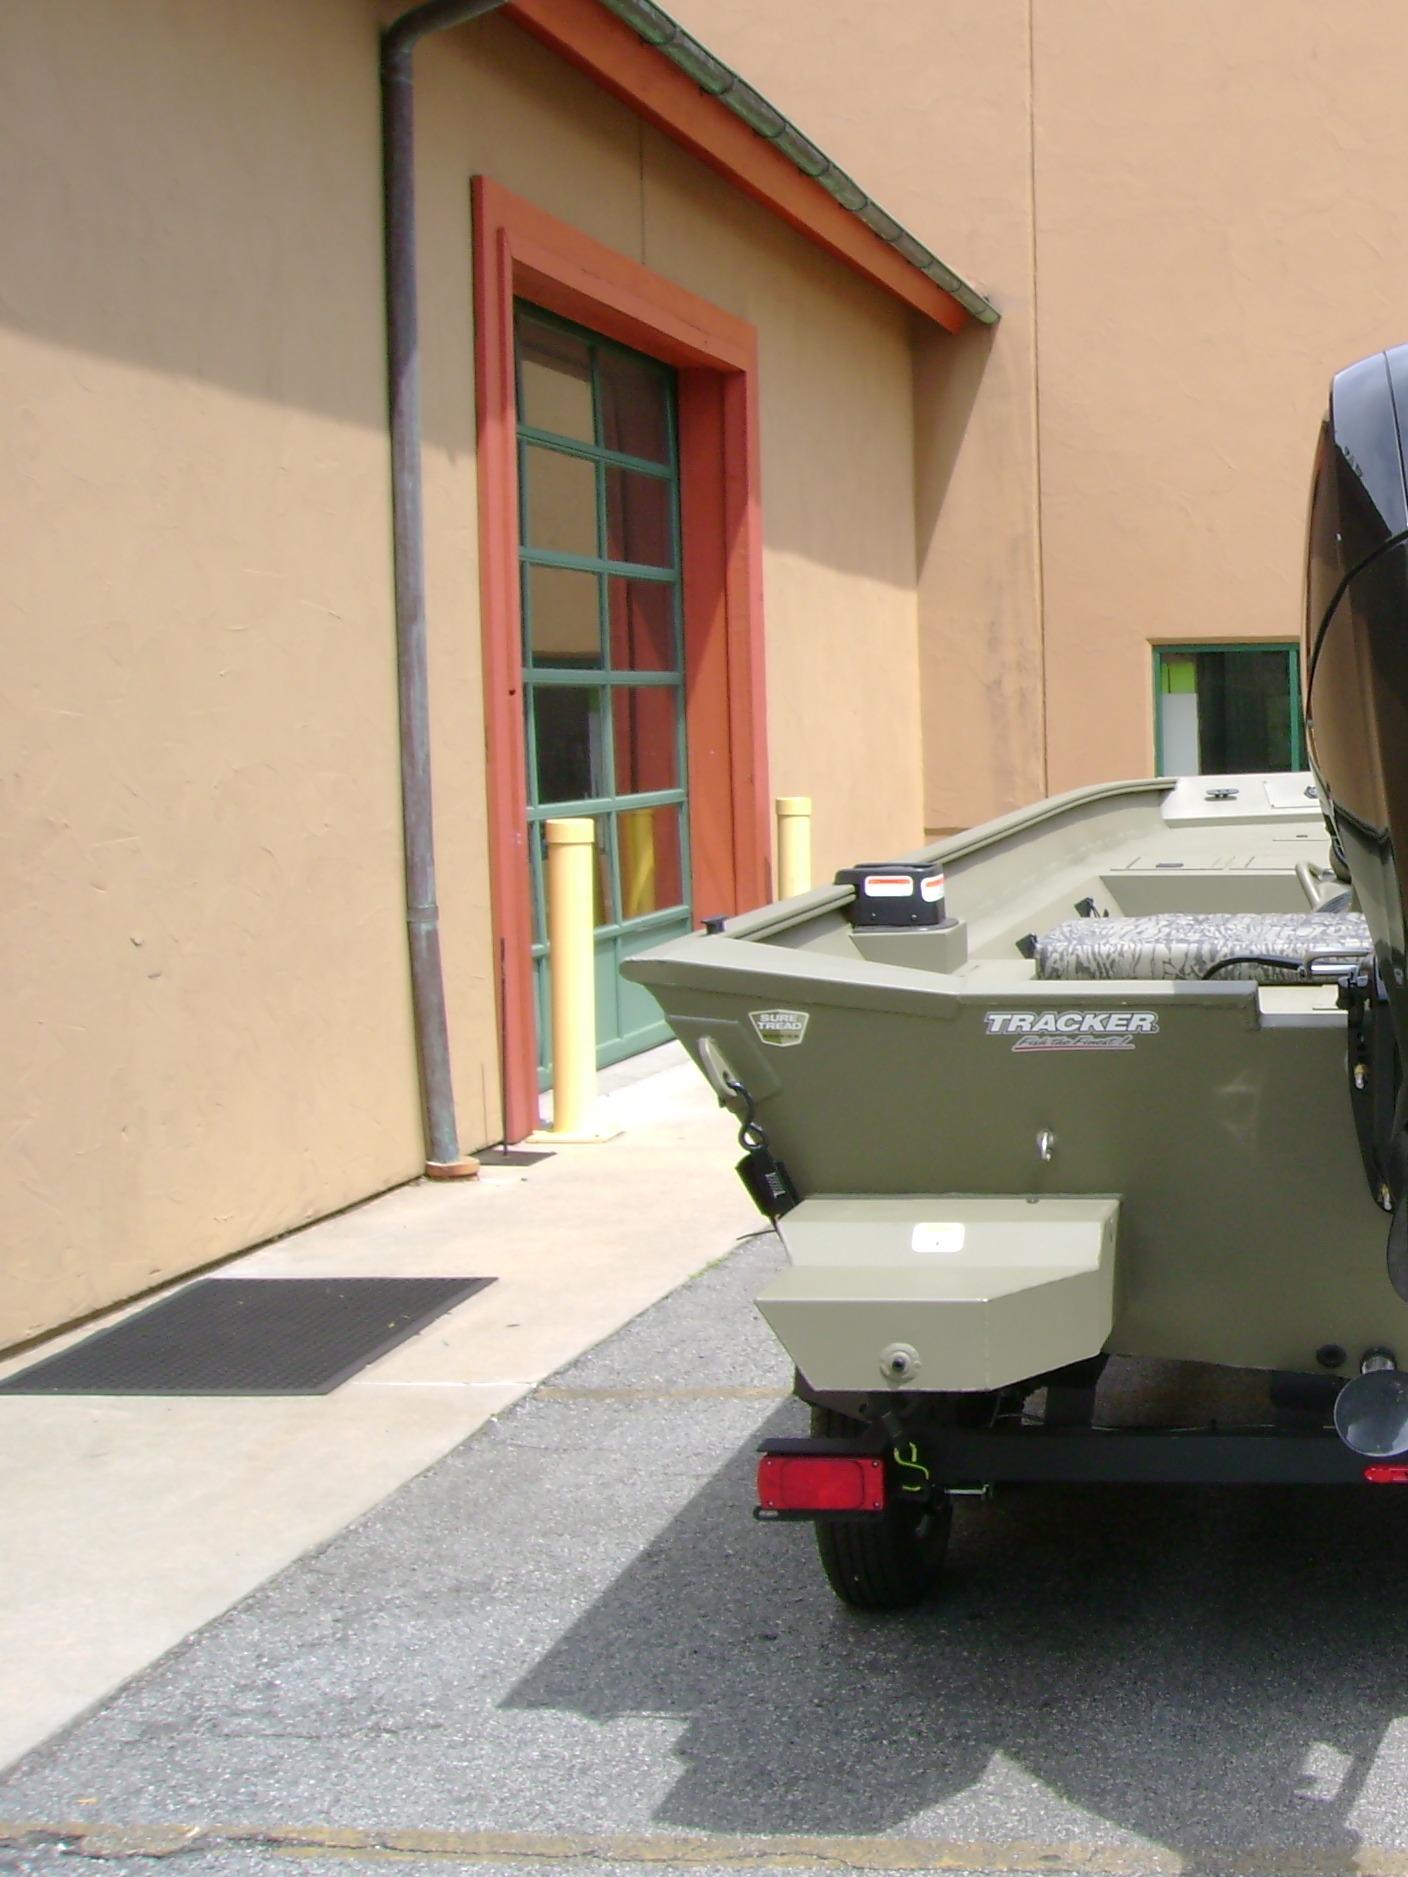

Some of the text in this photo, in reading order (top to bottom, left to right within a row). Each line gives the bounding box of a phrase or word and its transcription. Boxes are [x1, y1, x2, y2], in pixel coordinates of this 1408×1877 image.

[760, 1014, 798, 1022] SURE
[757, 1022, 802, 1030] TREAD
[986, 1013, 1156, 1033] TRACKER
